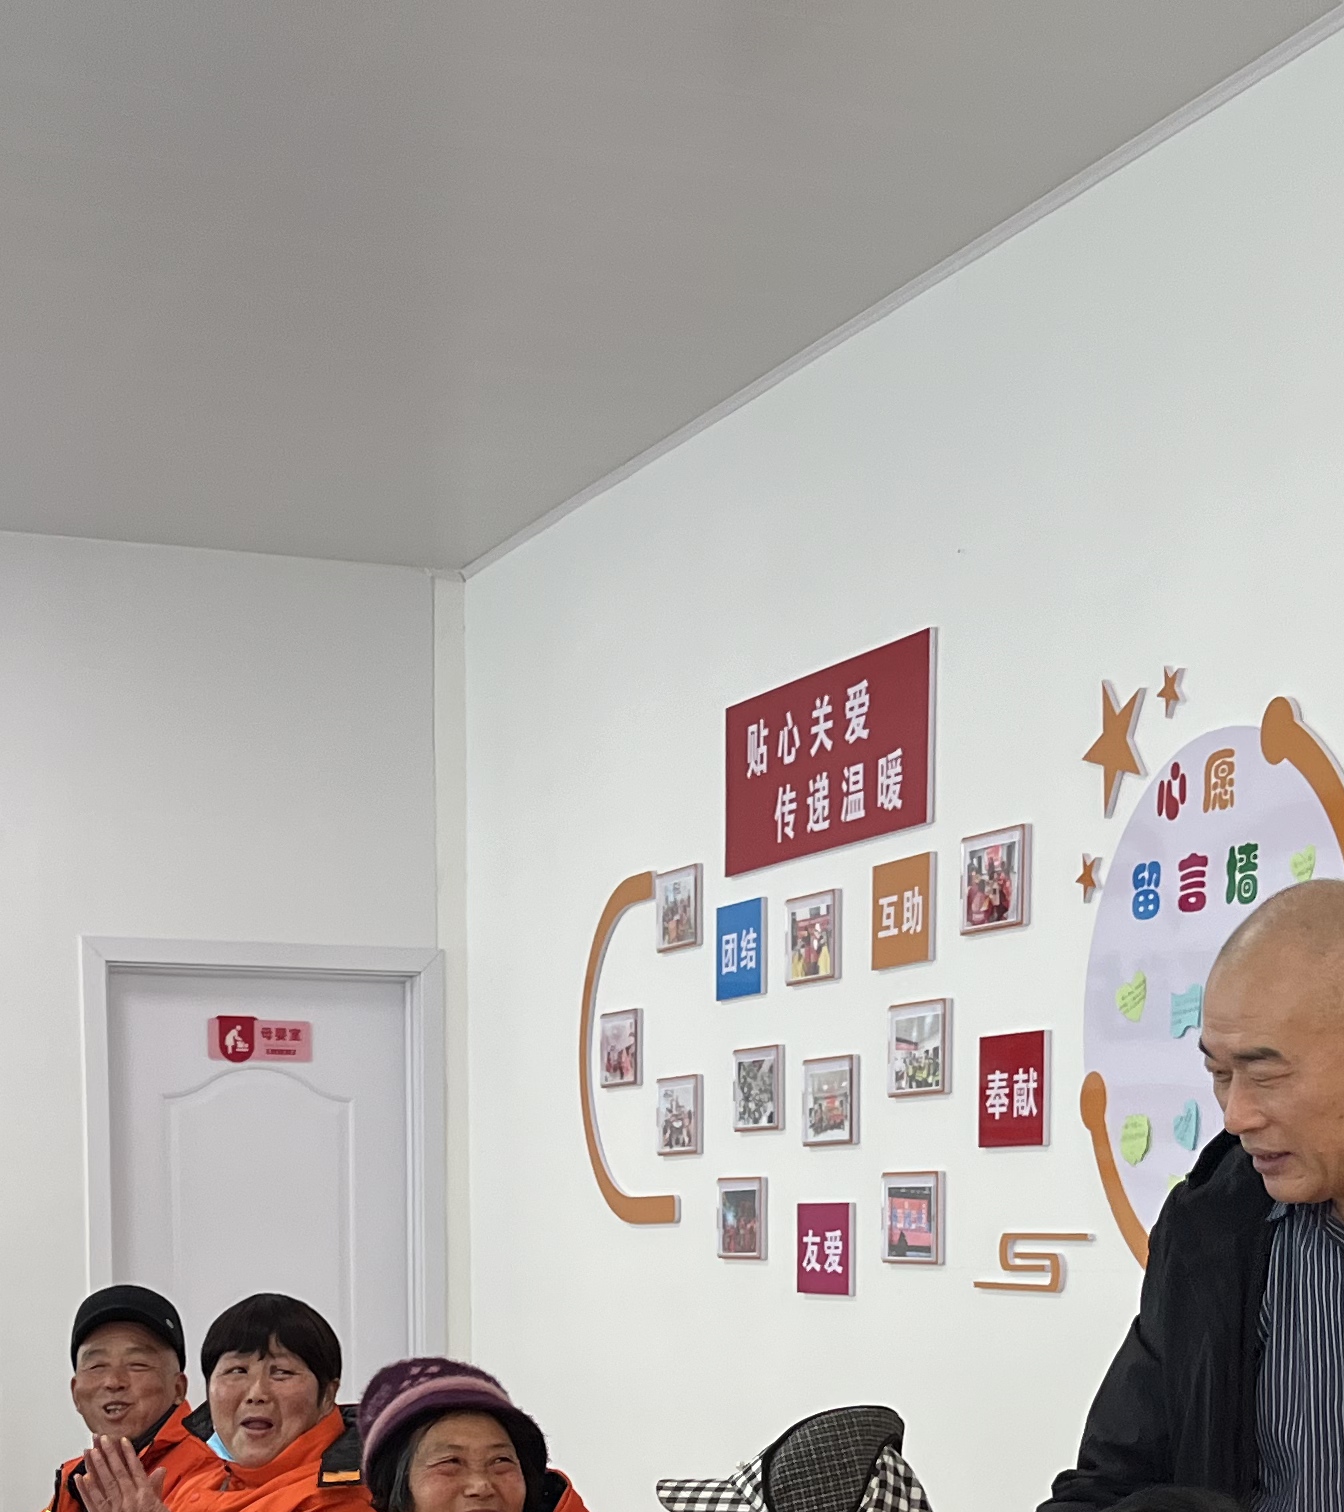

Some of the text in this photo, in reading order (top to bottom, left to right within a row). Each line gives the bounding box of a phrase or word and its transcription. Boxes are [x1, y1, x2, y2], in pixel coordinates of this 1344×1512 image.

[746, 679, 870, 779] 贴心关爱
[774, 747, 903, 843] 传递温暖
[1156, 748, 1236, 821] 心愿
[1131, 842, 1259, 921] 留言墙
[877, 886, 923, 939] 互助
[721, 926, 757, 975] 团结
[260, 1027, 303, 1042] 母婴室
[985, 1067, 1038, 1120] 奉献
[802, 1229, 844, 1274] 友爱
